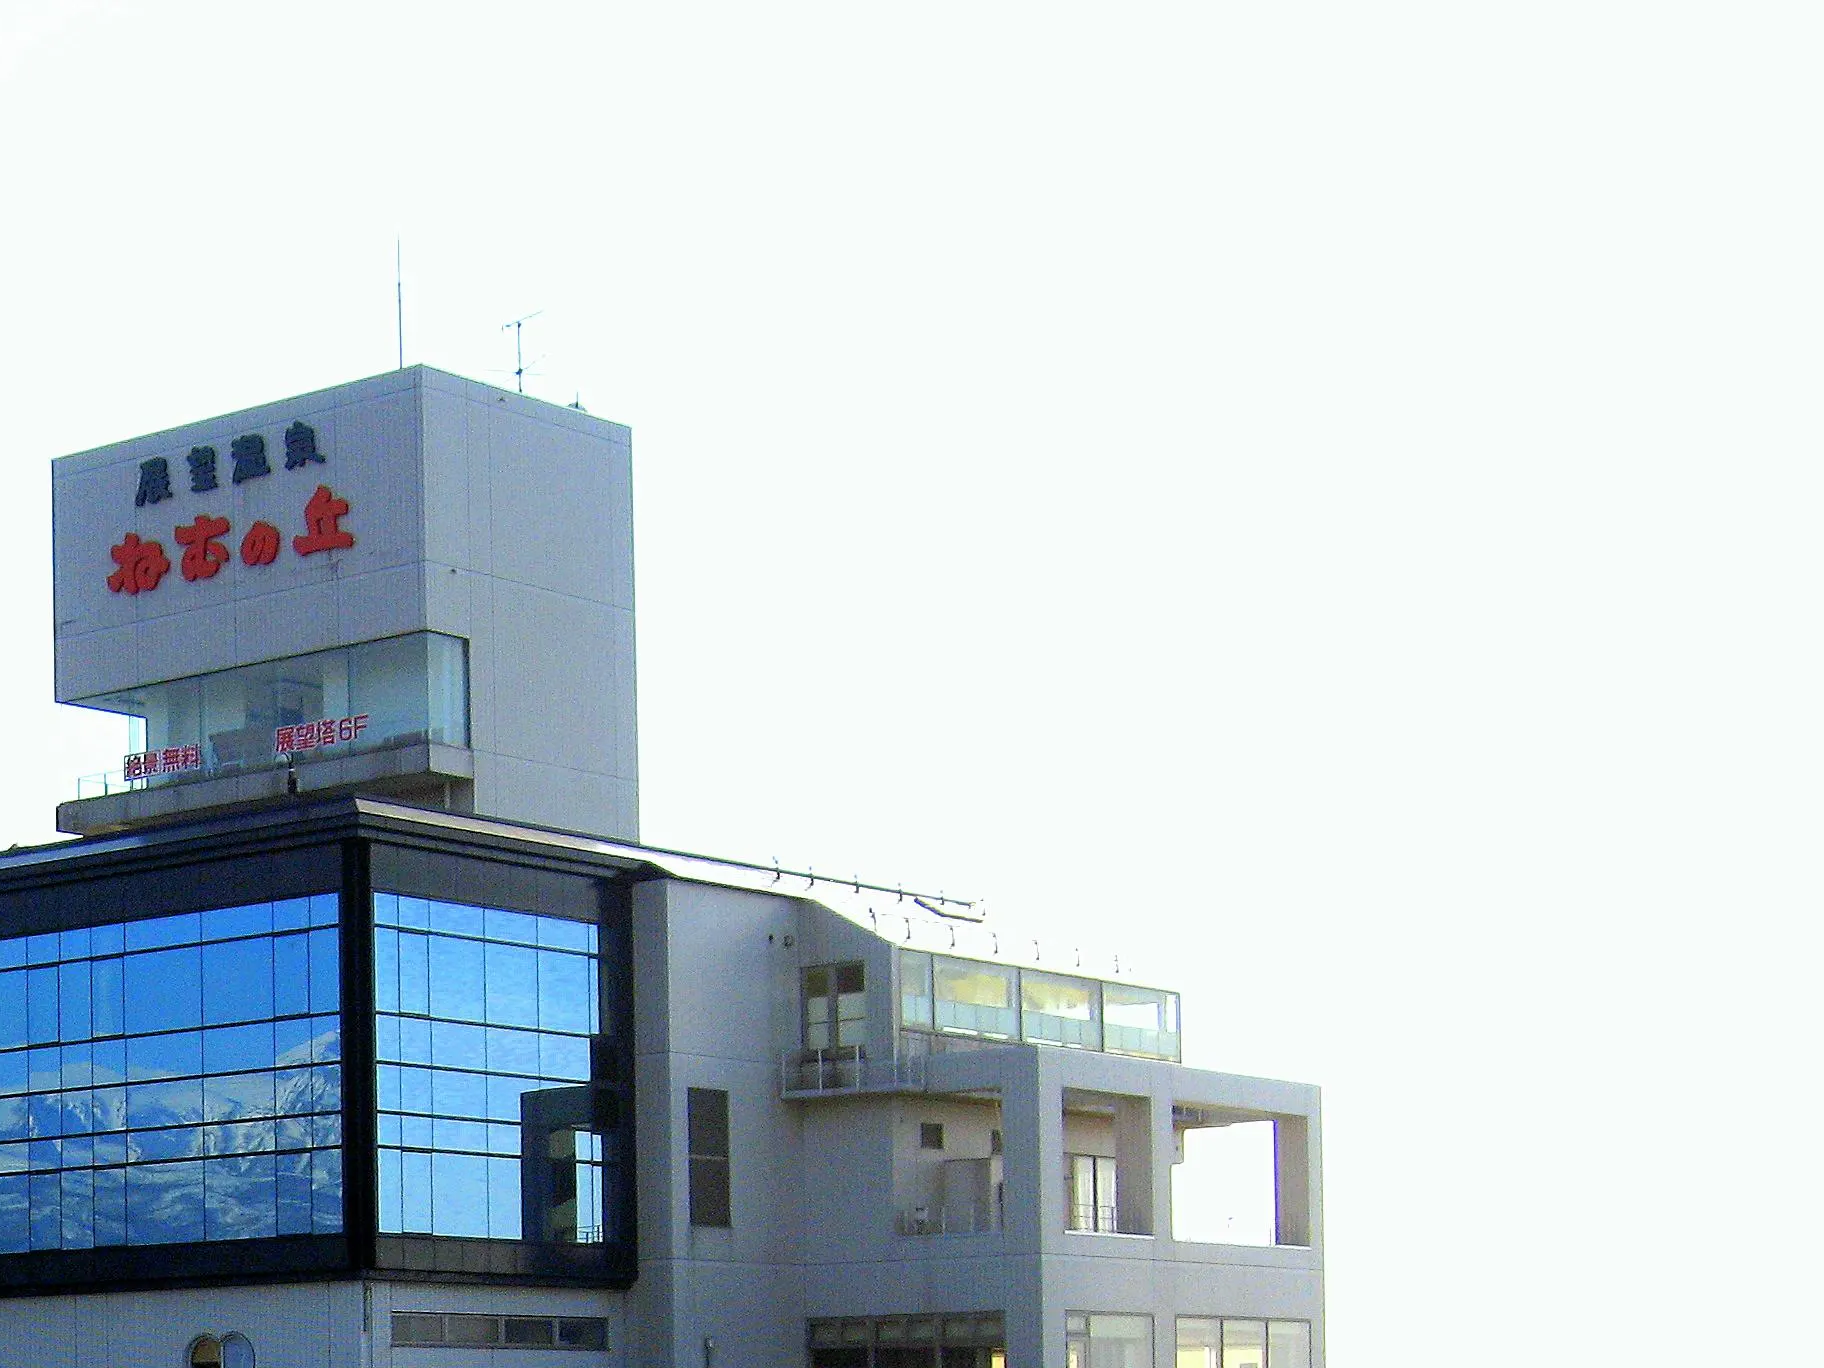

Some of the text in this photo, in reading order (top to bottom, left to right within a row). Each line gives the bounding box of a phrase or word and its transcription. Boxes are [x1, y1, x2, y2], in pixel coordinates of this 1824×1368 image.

[134, 419, 326, 507] 展望温泉
[106, 484, 355, 595] ねむの丘
